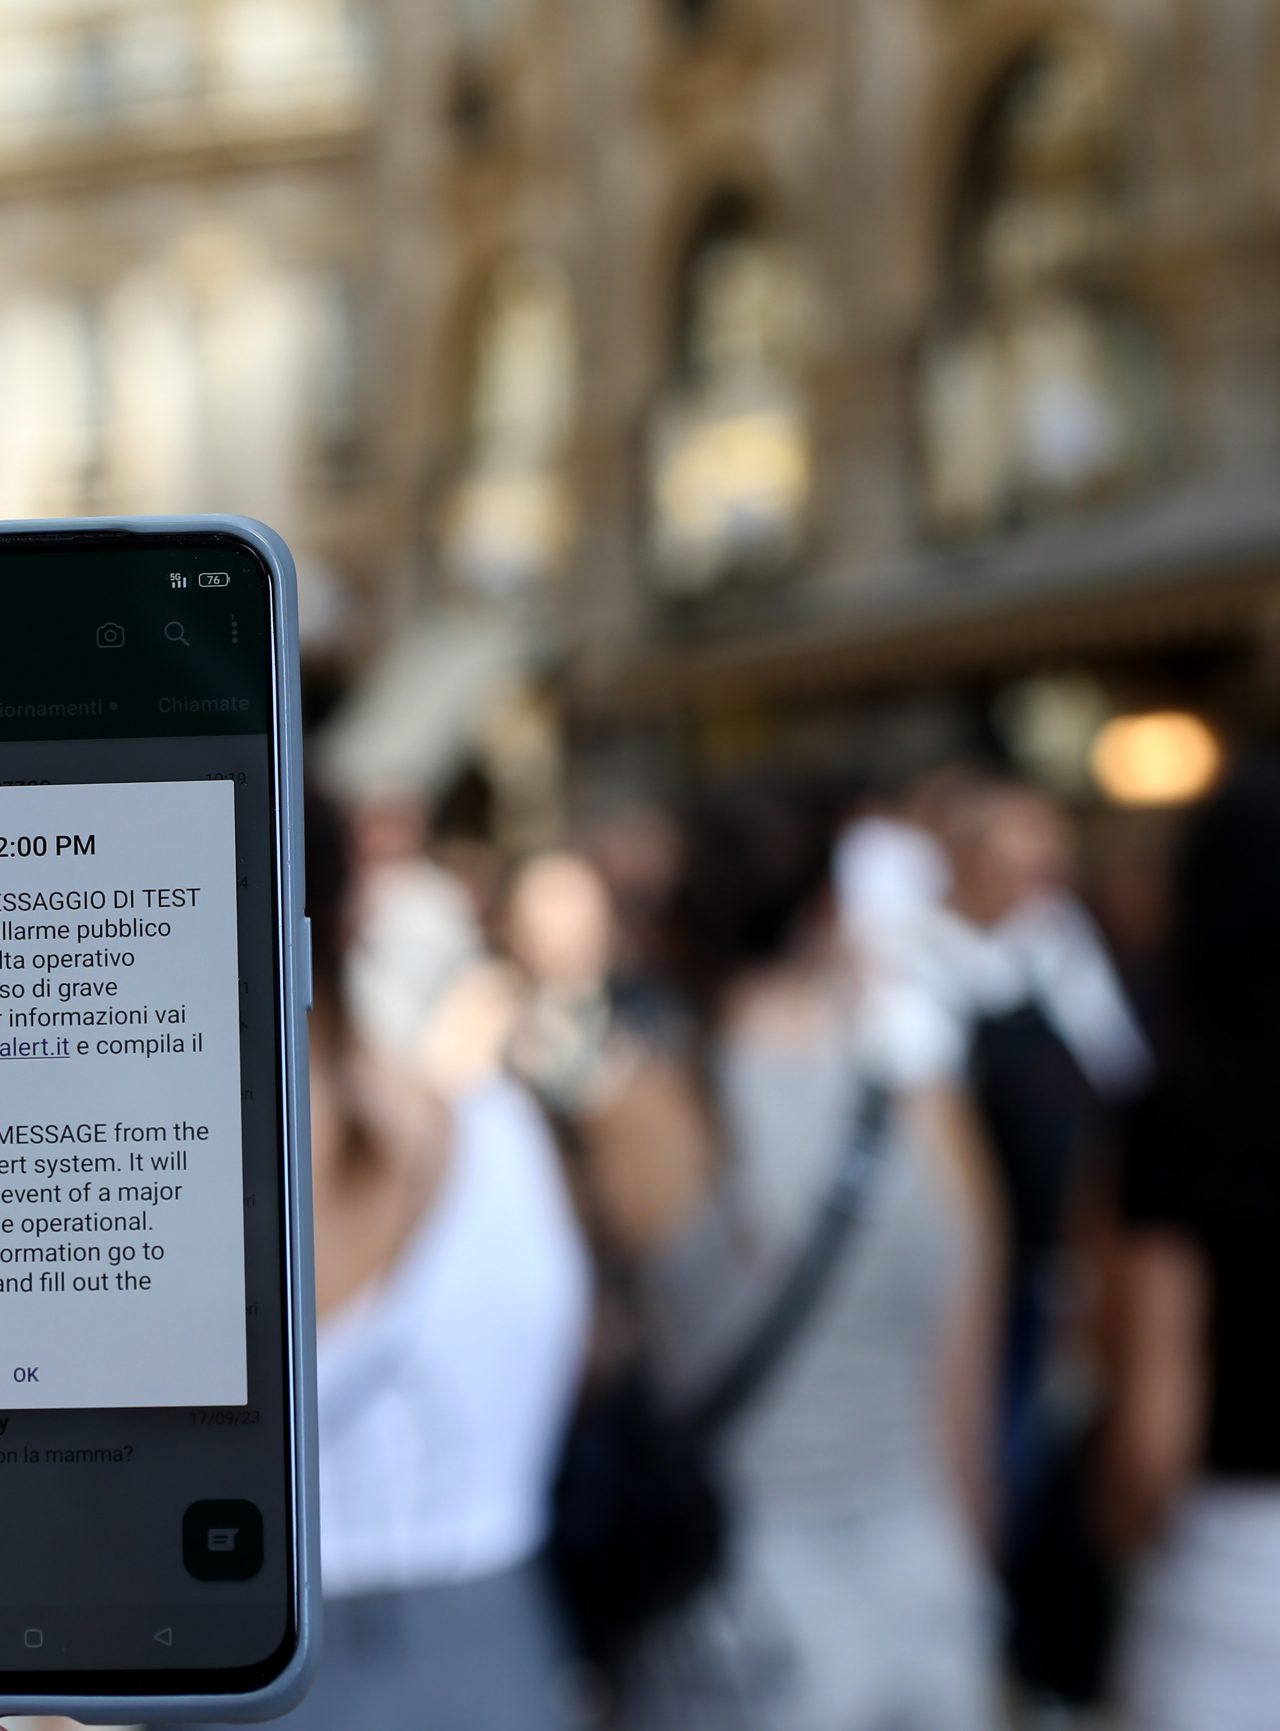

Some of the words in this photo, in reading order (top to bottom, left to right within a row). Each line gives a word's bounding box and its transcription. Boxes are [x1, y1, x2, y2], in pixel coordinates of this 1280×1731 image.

[207, 576, 220, 584] 76
[159, 696, 249, 712] Chiamate
[56, 835, 95, 855] PM
[114, 890, 134, 908] DI
[142, 888, 200, 907] TEST
[78, 918, 170, 943] pubblico
[33, 949, 134, 973] operativo
[33, 978, 50, 997] di
[59, 982, 117, 1002] grave
[10, 1006, 147, 1027] informazioni
[155, 1005, 185, 1023] vai
[77, 1041, 89, 1055] e
[97, 1033, 184, 1058] compila
[193, 1033, 202, 1052] il
[114, 1122, 166, 1142] from
[173, 1121, 208, 1141] the
[35, 1155, 120, 1178] system.
[131, 1153, 143, 1171] It
[151, 1151, 186, 1170] will
[2, 1185, 61, 1203] event
[69, 1182, 91, 1202] of
[99, 1187, 110, 1201] a
[119, 1182, 182, 1205] major
[22, 1211, 152, 1237] operational.
[109, 1246, 135, 1266] go
[143, 1243, 164, 1260] to
[40, 1272, 64, 1291] fill
[73, 1274, 108, 1291] out
[116, 1271, 151, 1290] the
[14, 1368, 38, 1382] OK
[190, 1411, 261, 1426] 17/09/23
[24, 1446, 39, 1463] la
[46, 1444, 133, 1462] mamma?
